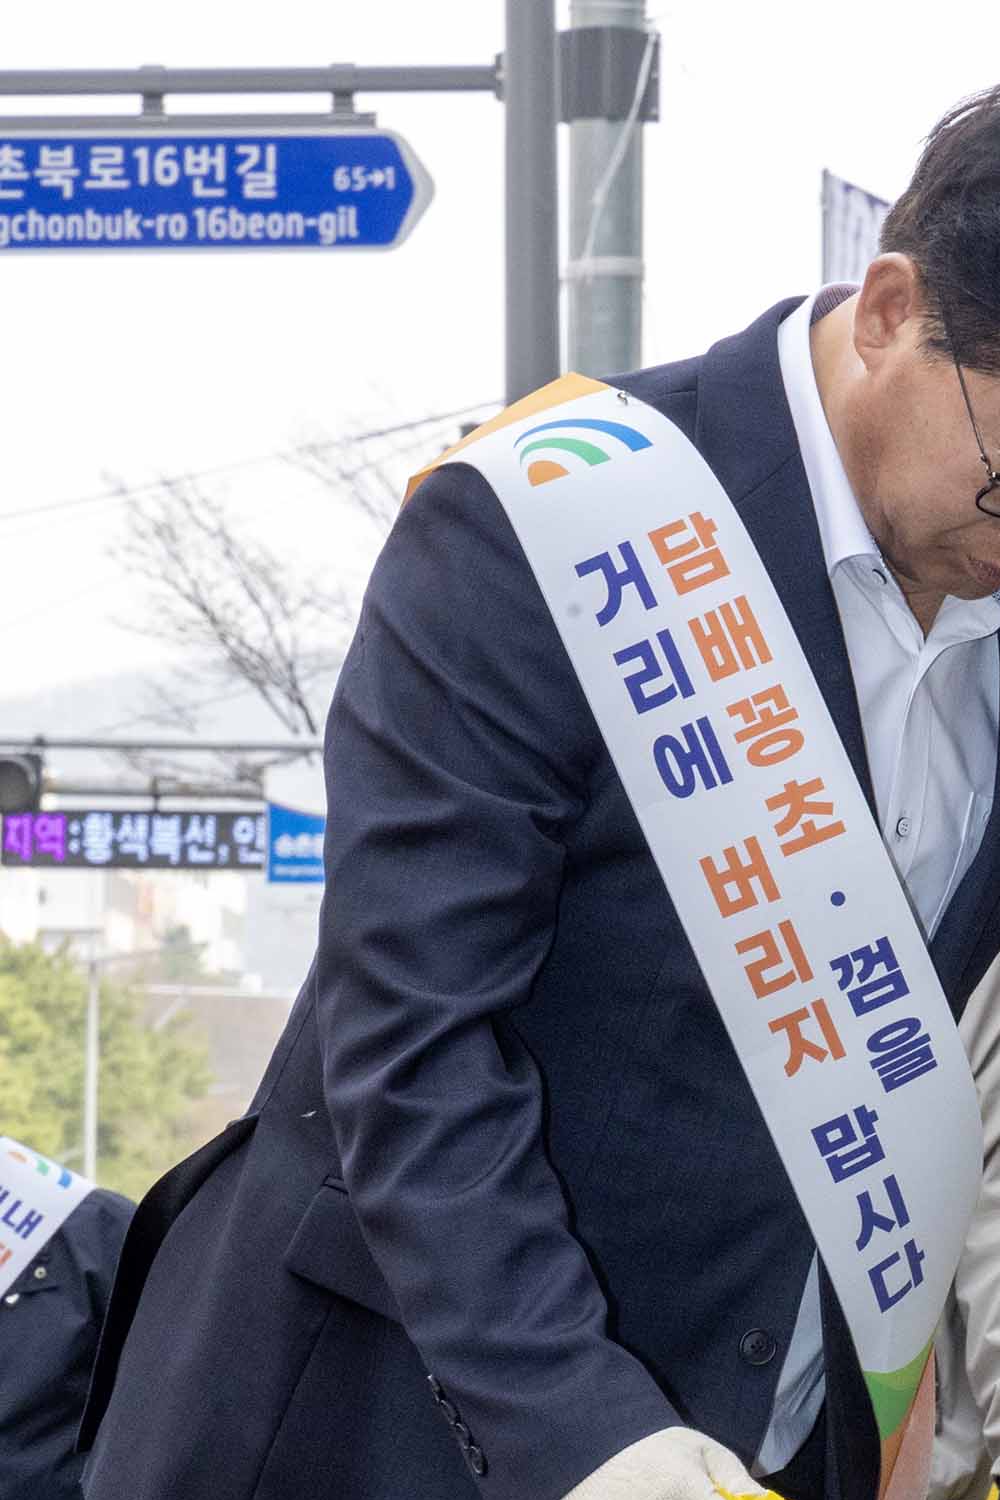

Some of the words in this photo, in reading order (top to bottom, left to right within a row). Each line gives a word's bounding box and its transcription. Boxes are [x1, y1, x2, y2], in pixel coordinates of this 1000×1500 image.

[0, 143, 278, 199] 촌북로16번길
[194, 206, 358, 245] 16beon-gil
[574, 540, 734, 799] 거리에
[699, 835, 847, 1079] 버리지
[810, 1104, 925, 1314] 맙시다
